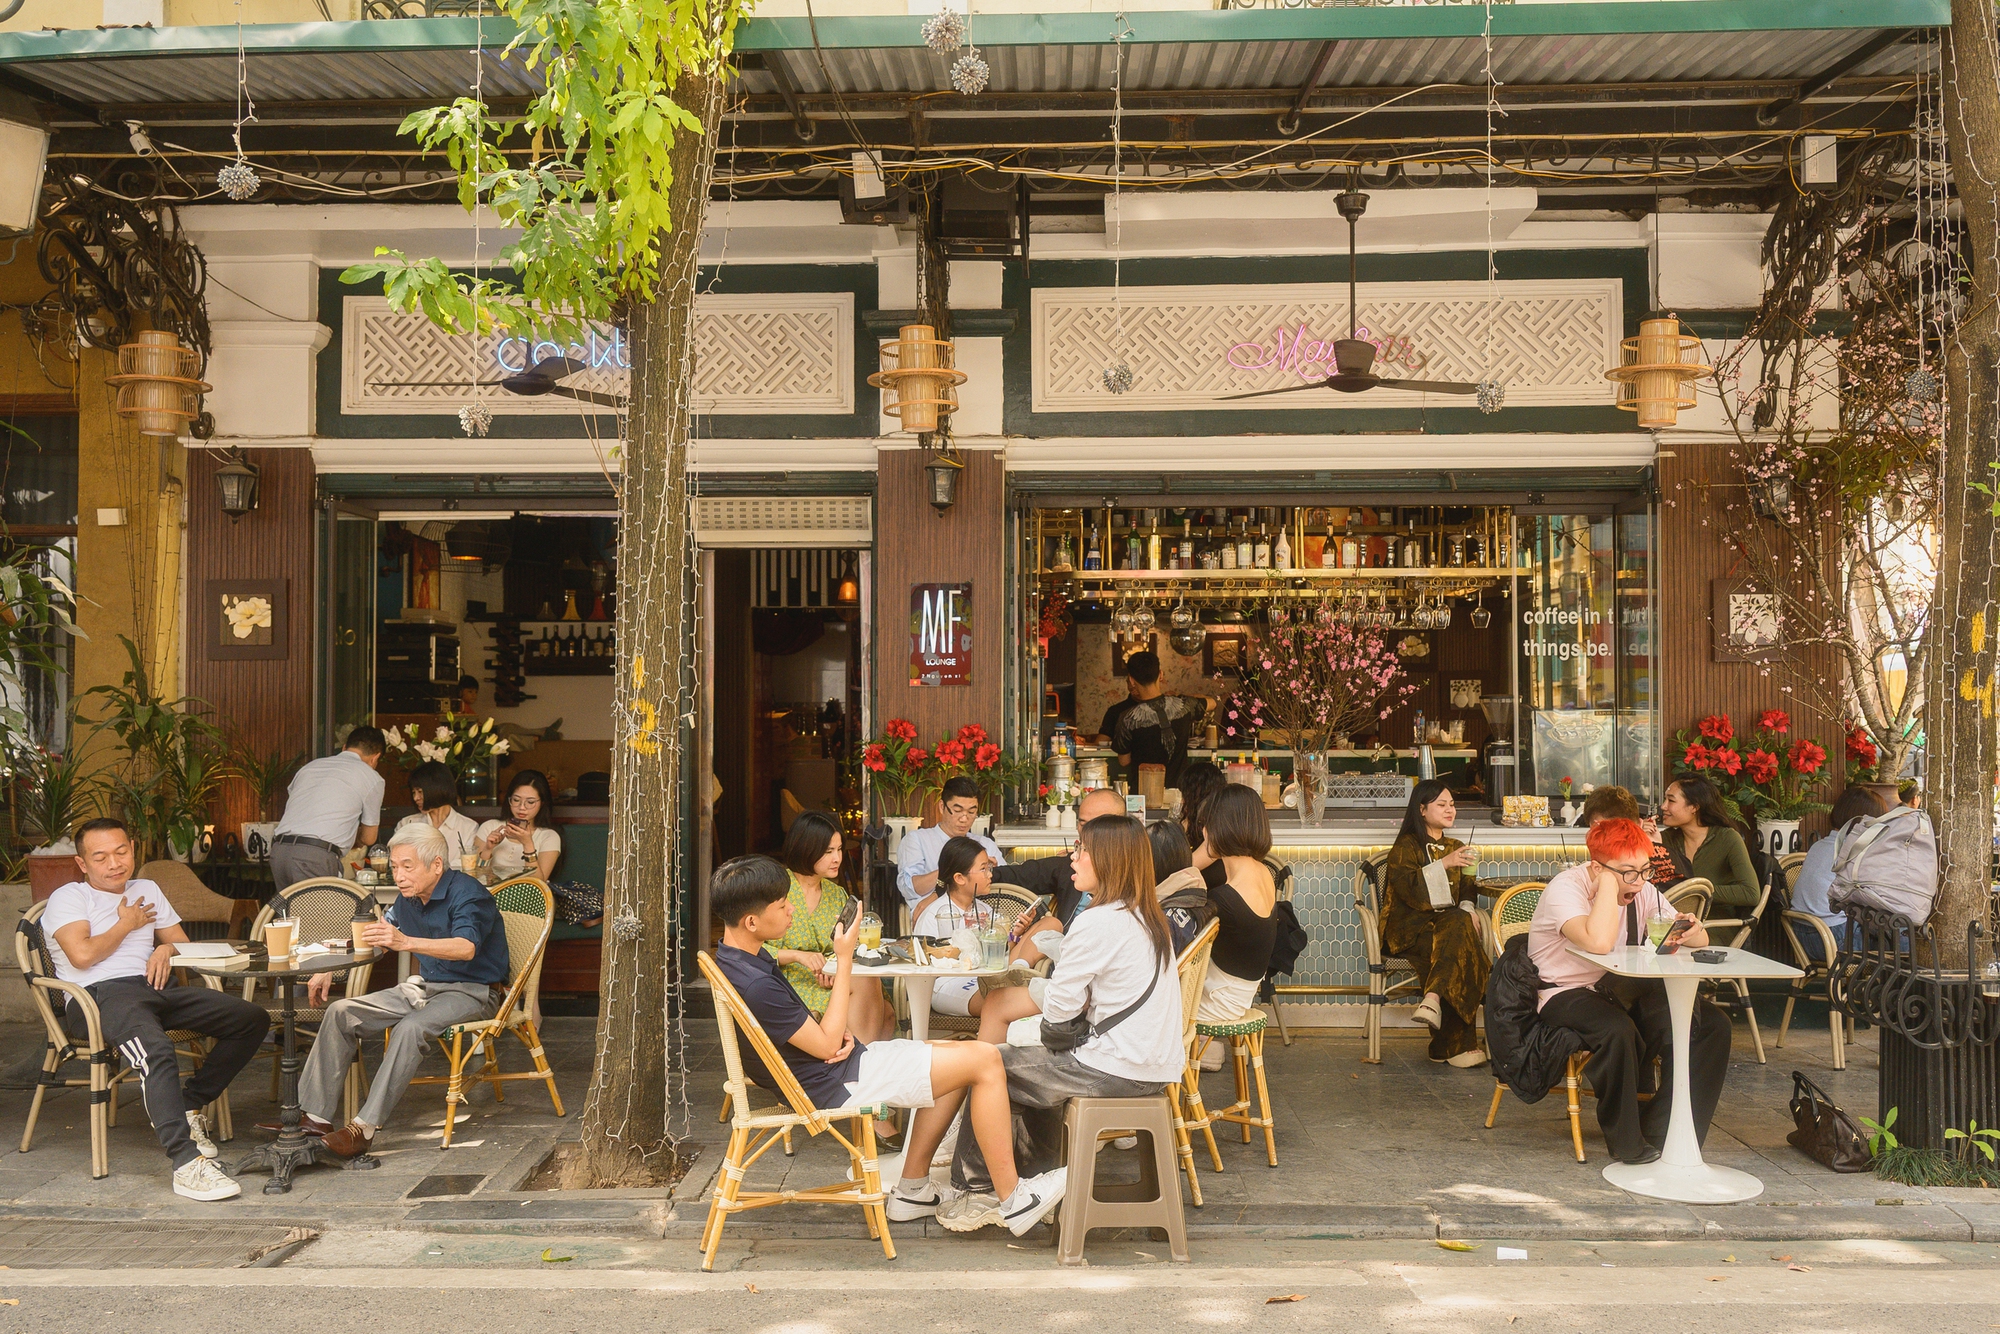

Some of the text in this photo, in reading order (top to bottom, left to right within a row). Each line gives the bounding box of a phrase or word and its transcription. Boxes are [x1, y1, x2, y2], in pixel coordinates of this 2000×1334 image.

[920, 590, 962, 653] MF
[1523, 607, 1578, 625] coffee
[1584, 607, 1601, 625] in
[1607, 608, 1614, 625] t
[1523, 639, 1612, 661] things be.
[925, 658, 957, 666] LOUNGE
